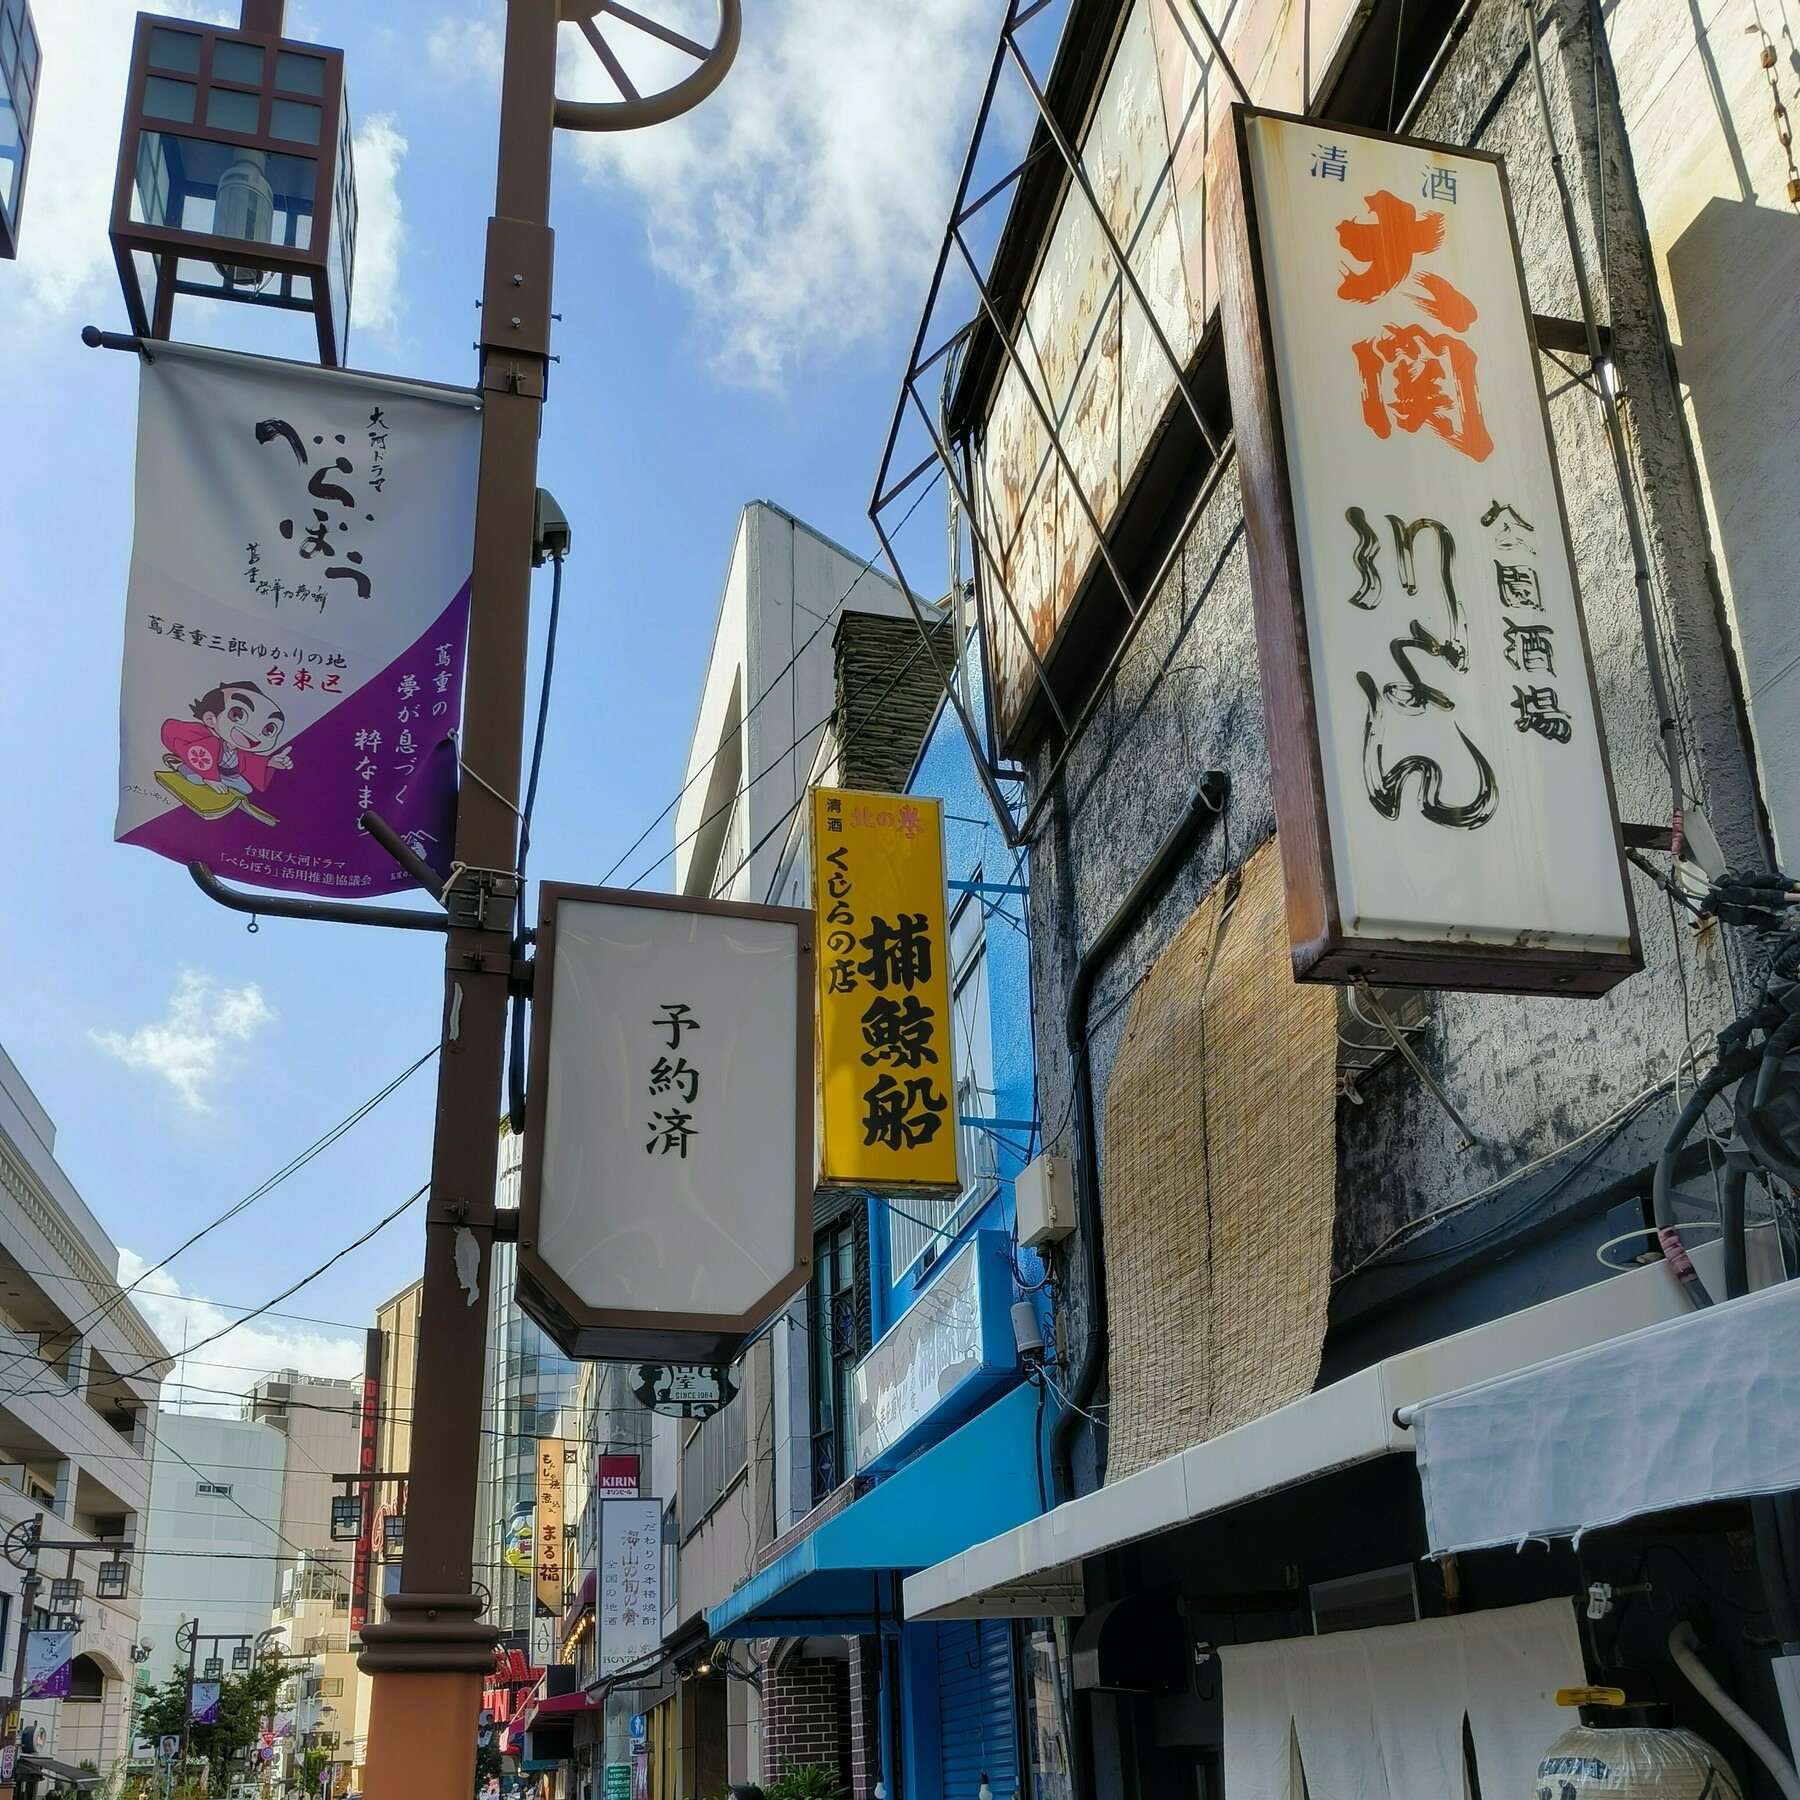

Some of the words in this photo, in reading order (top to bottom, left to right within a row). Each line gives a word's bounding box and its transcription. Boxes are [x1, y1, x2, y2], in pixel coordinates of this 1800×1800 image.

[1309, 142, 1459, 206] 清酒
[1335, 189, 1495, 463] 大関
[366, 406, 391, 493] 大河ドラマ
[254, 416, 375, 600] べらぼう
[147, 614, 348, 670] 蔦屋重三郎ゆかりの地
[1480, 496, 1573, 745] 公園酒場
[266, 665, 343, 695] 台東区
[432, 643, 453, 717] 蔦重の
[393, 673, 422, 805] 夢が息づく
[826, 796, 843, 833] 清酒
[244, 845, 346, 869] 台東区大河ドラマ
[825, 846, 860, 996] くじらの店
[857, 912, 950, 1153] 捕鯨船
[645, 1003, 701, 1160] 予約済
[675, 1391, 697, 1399] SINCE
[602, 1476, 637, 1487] KIRIN
[539, 1524, 560, 1582] まる福
[642, 1510, 658, 1626] こだわりの本格焼酎
[604, 1559, 619, 1626] 全国の地酒
